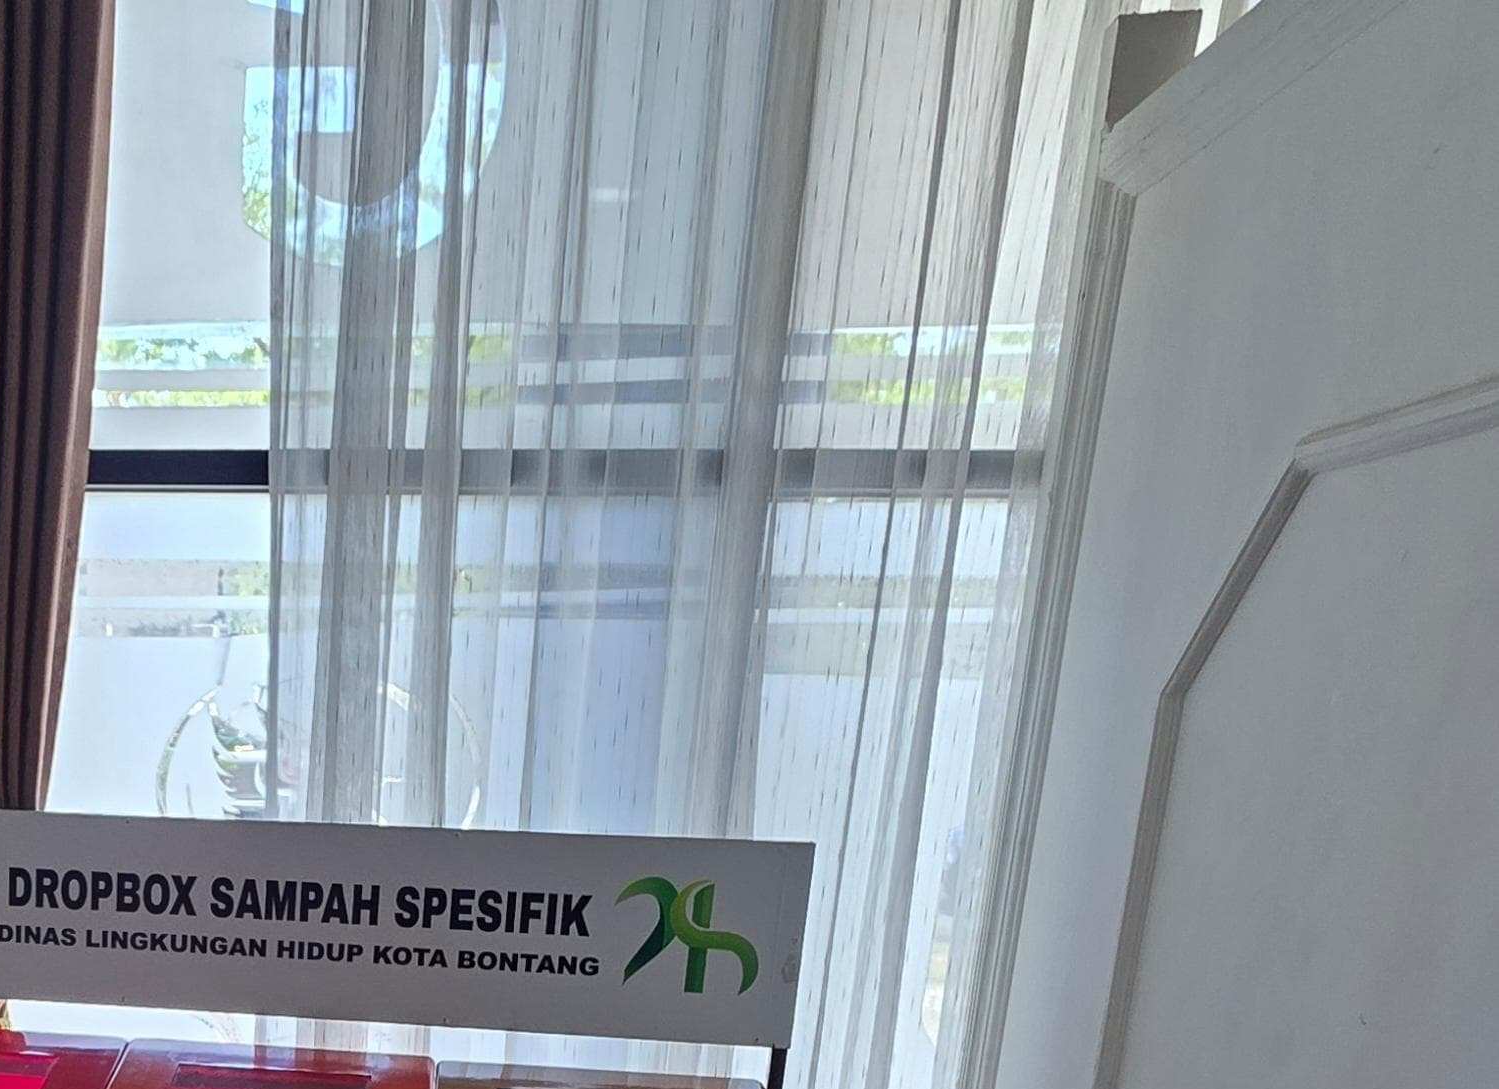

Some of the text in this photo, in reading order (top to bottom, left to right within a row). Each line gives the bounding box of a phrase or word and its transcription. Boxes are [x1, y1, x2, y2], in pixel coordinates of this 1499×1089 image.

[7, 866, 592, 938] DROPBOX SAMPAH SPESIFIK
[85, 929, 267, 958] LINGKUNGAN
[276, 940, 364, 964] HIDUP
[373, 944, 449, 969] KOTA
[457, 949, 601, 978] BONTANG
